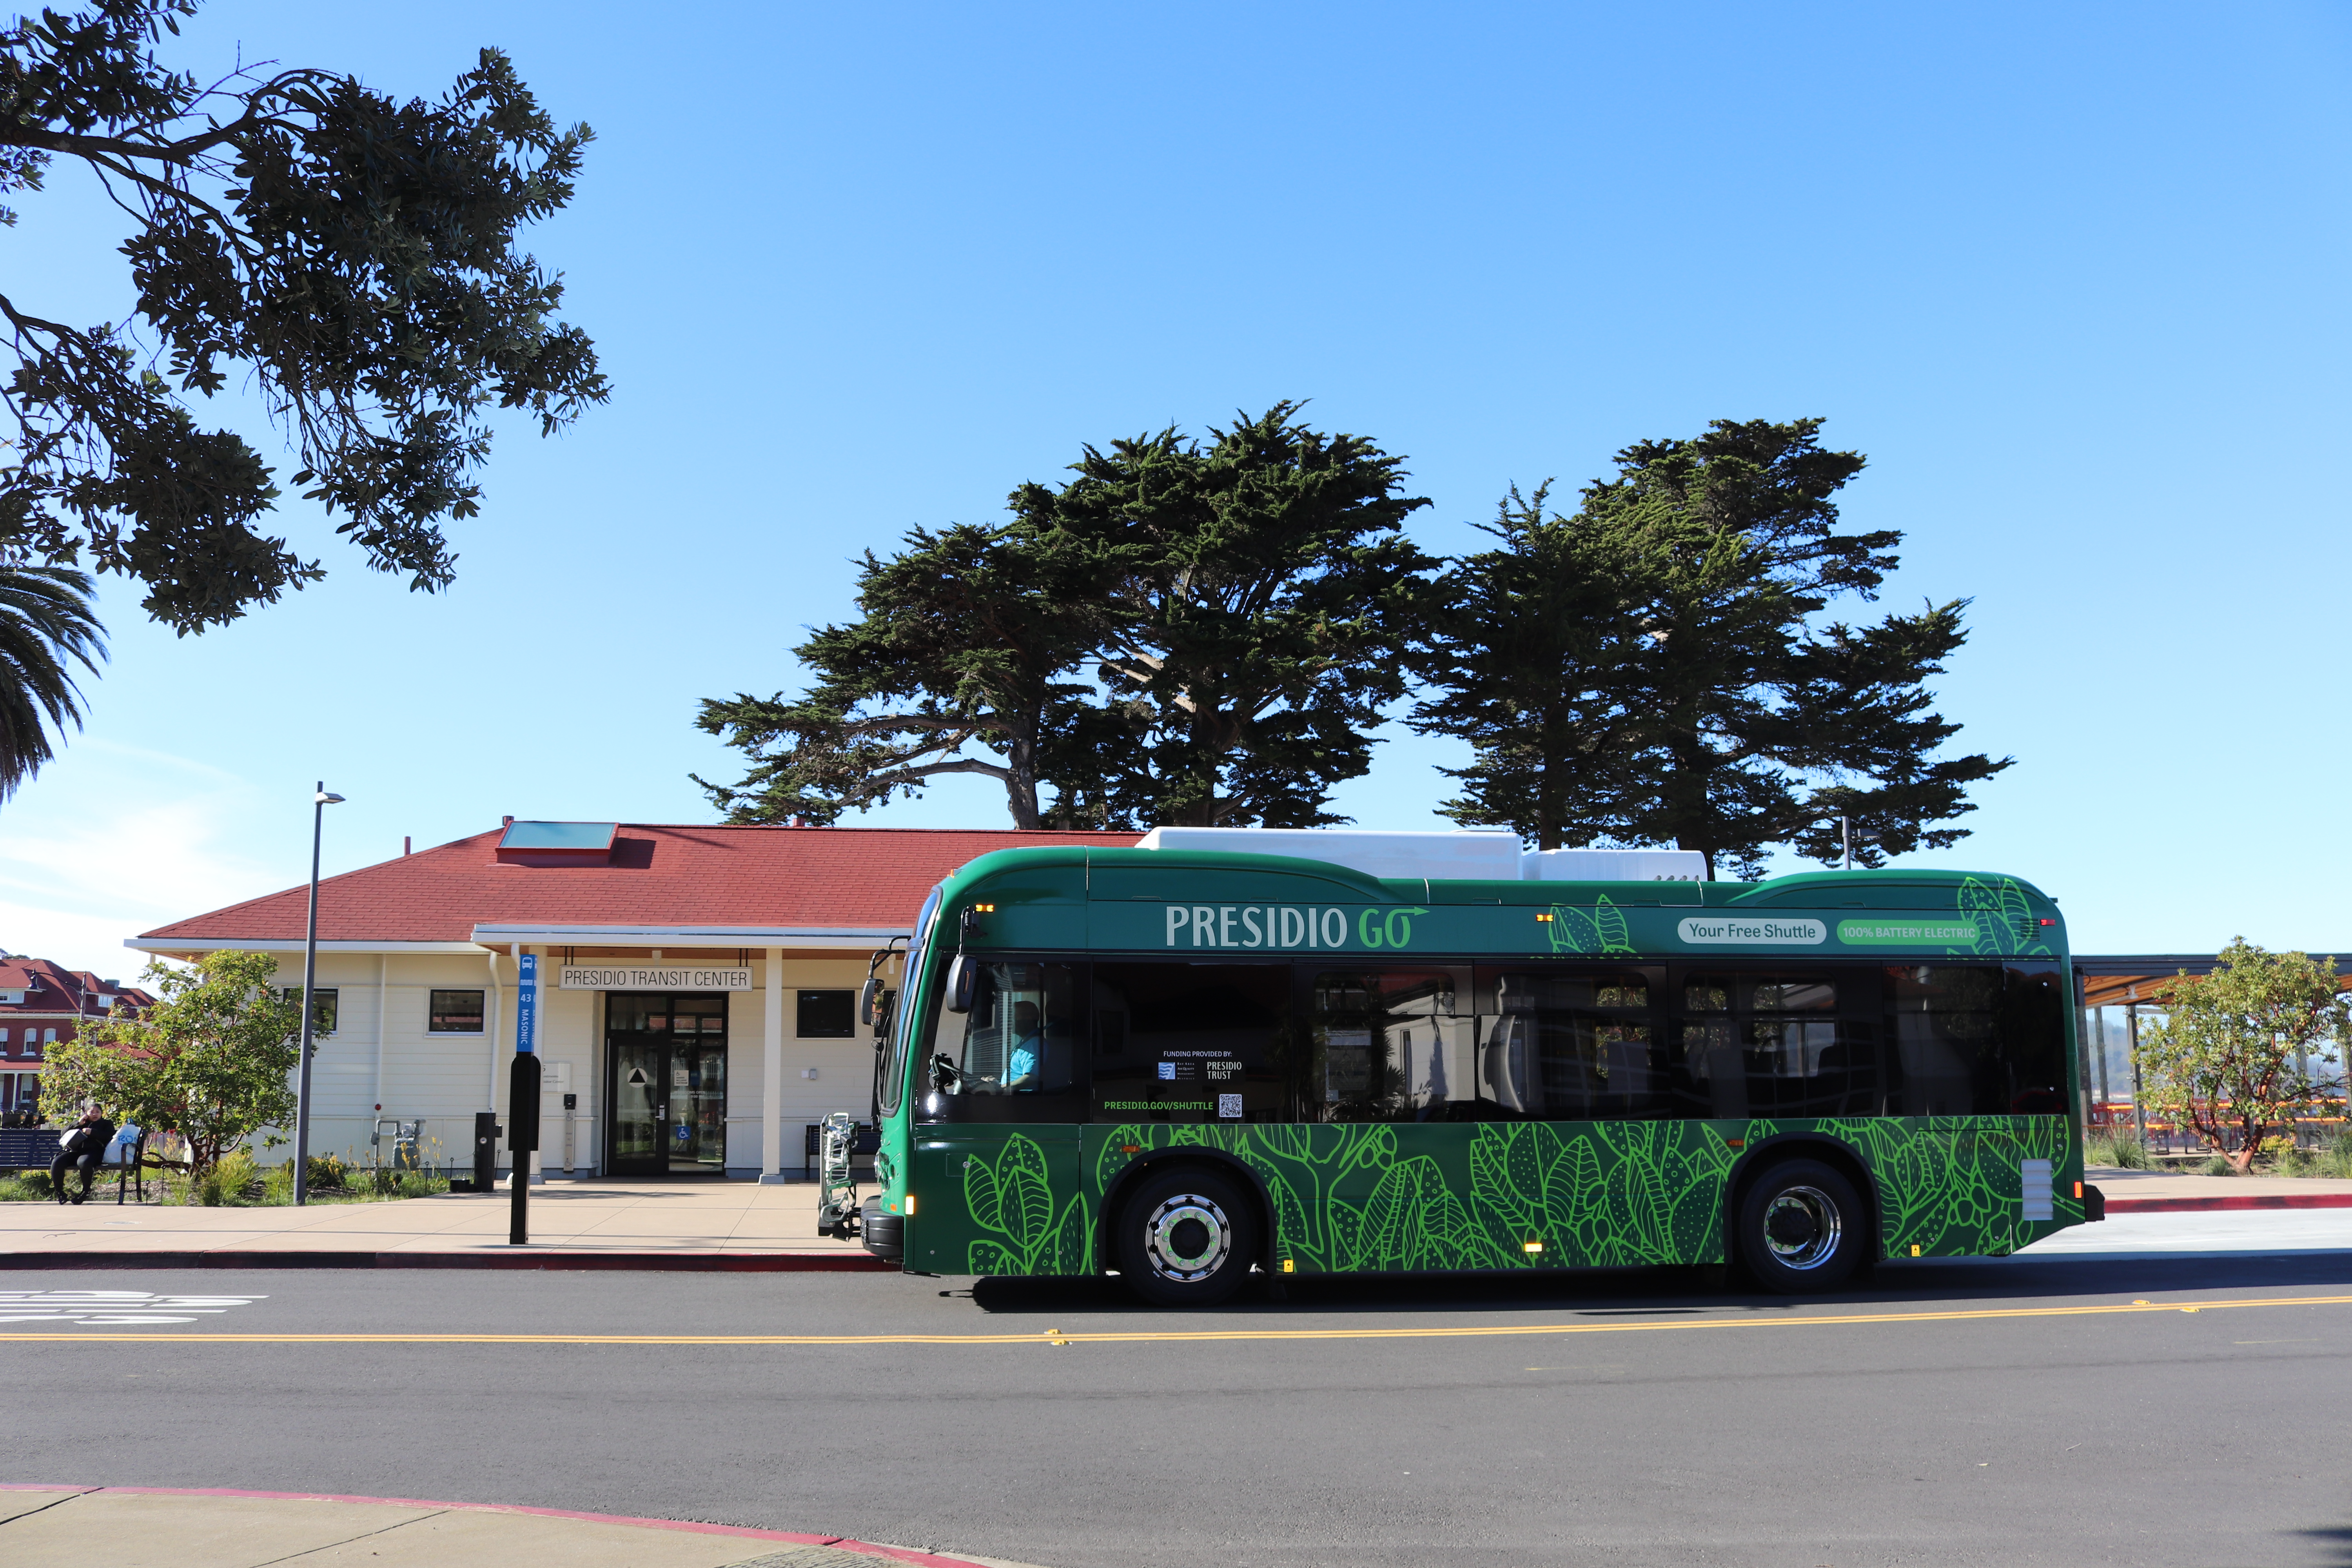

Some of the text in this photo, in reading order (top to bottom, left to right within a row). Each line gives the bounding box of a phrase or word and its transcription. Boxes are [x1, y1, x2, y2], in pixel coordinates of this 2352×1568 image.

[1166, 906, 1411, 948] PRESIDIO GO
[1689, 923, 1816, 938] Your Free Shuttle
[1843, 927, 1976, 938] 100% BATTERY ELECTRIC
[565, 970, 747, 986] PRESIDIO TRANSIT CENTER
[520, 994, 532, 1002] 43
[521, 1009, 529, 1044] MASONIC
[1207, 1062, 1242, 1070] PRESIDIO
[1207, 1071, 1231, 1079] TRUST
[1104, 1102, 1213, 1110] PRESIDIO.GOV/SHUTTLE
